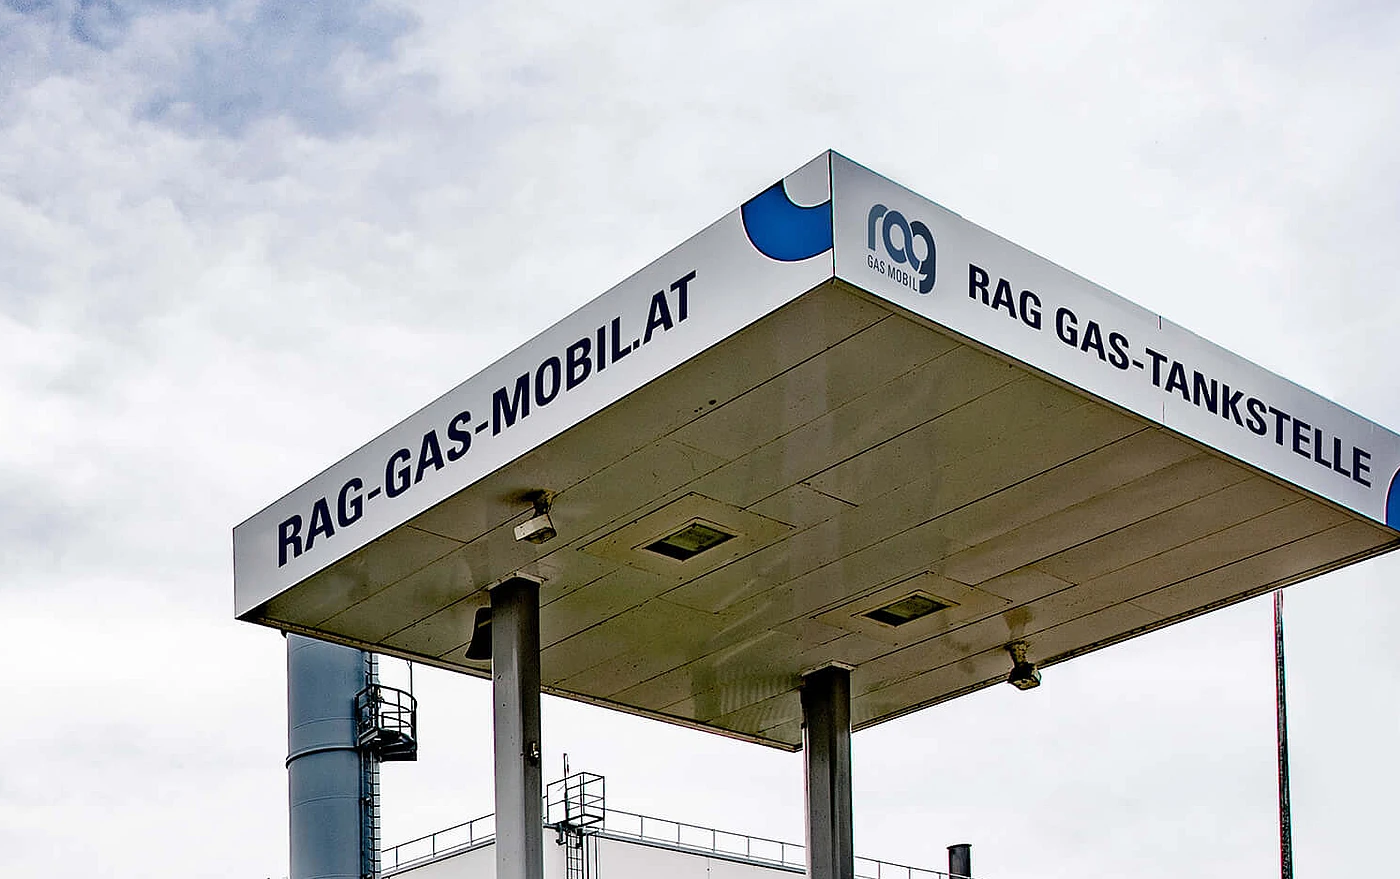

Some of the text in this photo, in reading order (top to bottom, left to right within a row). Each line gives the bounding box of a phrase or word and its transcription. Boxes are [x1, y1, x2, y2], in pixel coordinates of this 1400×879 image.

[867, 254, 918, 292] GAS MOBIL
[968, 263, 1372, 488] RAG GAS-TANKSTELLE
[278, 270, 697, 568] RAG-GAS-MOBIL.AT
